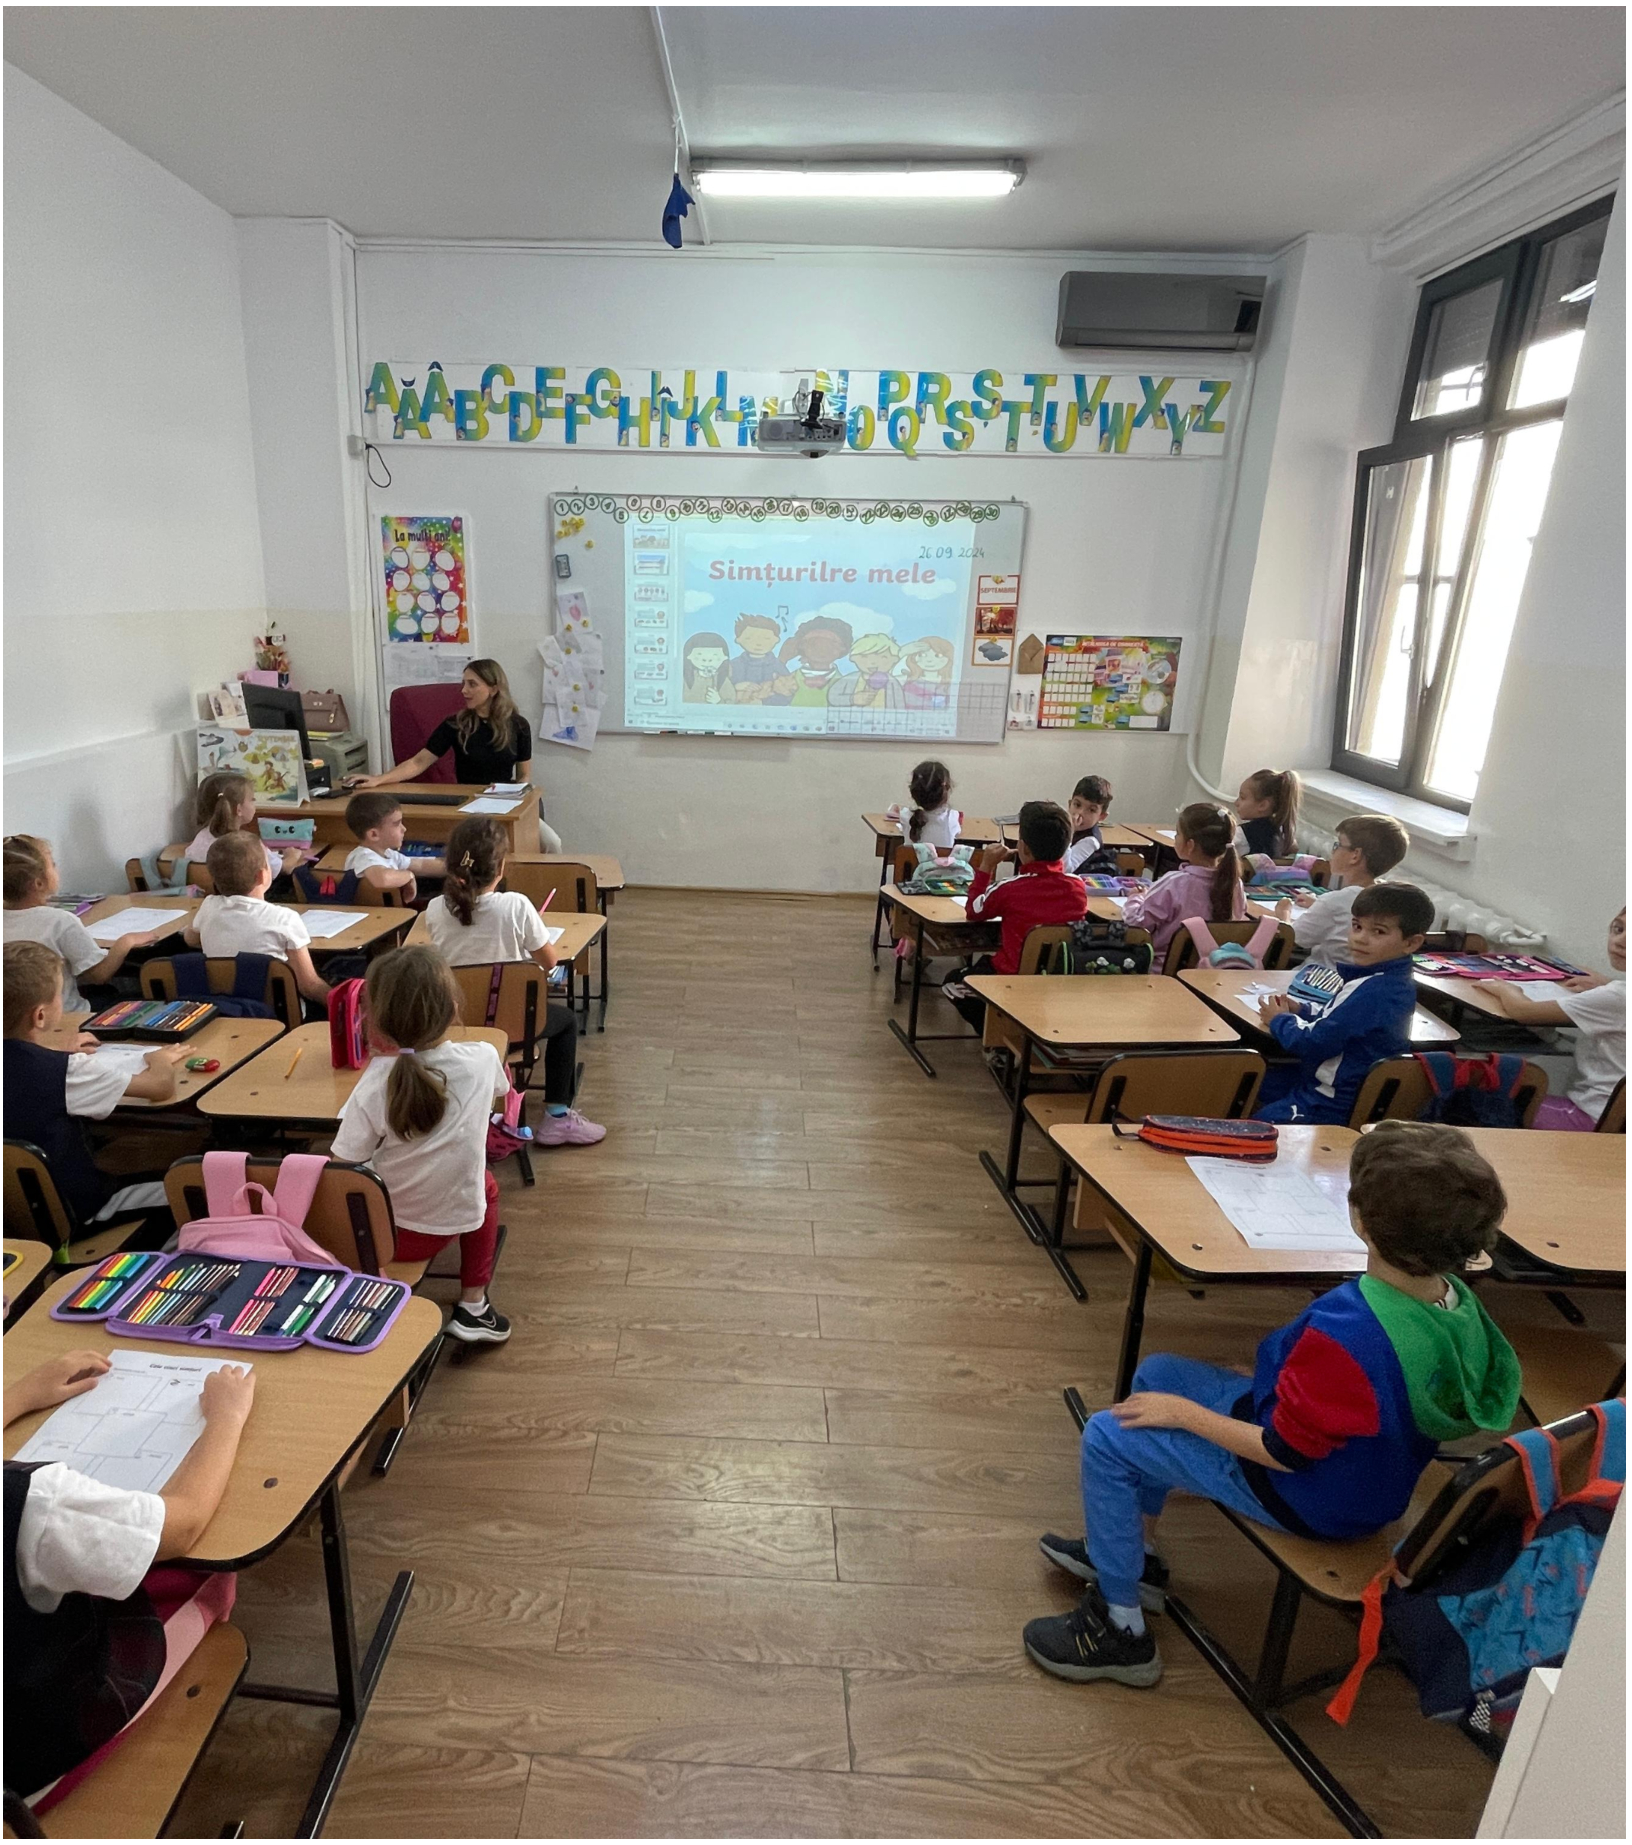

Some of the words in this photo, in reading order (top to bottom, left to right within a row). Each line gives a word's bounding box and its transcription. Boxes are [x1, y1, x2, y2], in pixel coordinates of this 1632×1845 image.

[364, 362, 400, 413] A
[481, 364, 515, 414] C
[536, 366, 565, 418] E
[586, 368, 621, 418] G
[668, 370, 696, 420] J
[715, 371, 744, 422] L
[877, 370, 910, 421] P
[915, 371, 951, 424] R
[1074, 374, 1111, 426] V
[1133, 376, 1175, 429] X
[1192, 380, 1231, 433] Z
[454, 390, 489, 441] B
[509, 391, 542, 442] D
[565, 393, 592, 444] F
[618, 396, 650, 447] H
[686, 396, 721, 447] K
[846, 405, 875, 451] O
[888, 406, 919, 457] Q
[943, 400, 974, 451] S
[1001, 401, 1032, 451] T
[1044, 401, 1078, 452] U
[1098, 402, 1137, 453] W
[1165, 403, 1201, 455] Y
[394, 529, 405, 542] La
[919, 546, 933, 559] 26
[958, 547, 985, 559] 2024
[708, 560, 857, 588] Simțurilre
[867, 563, 936, 584] mele
